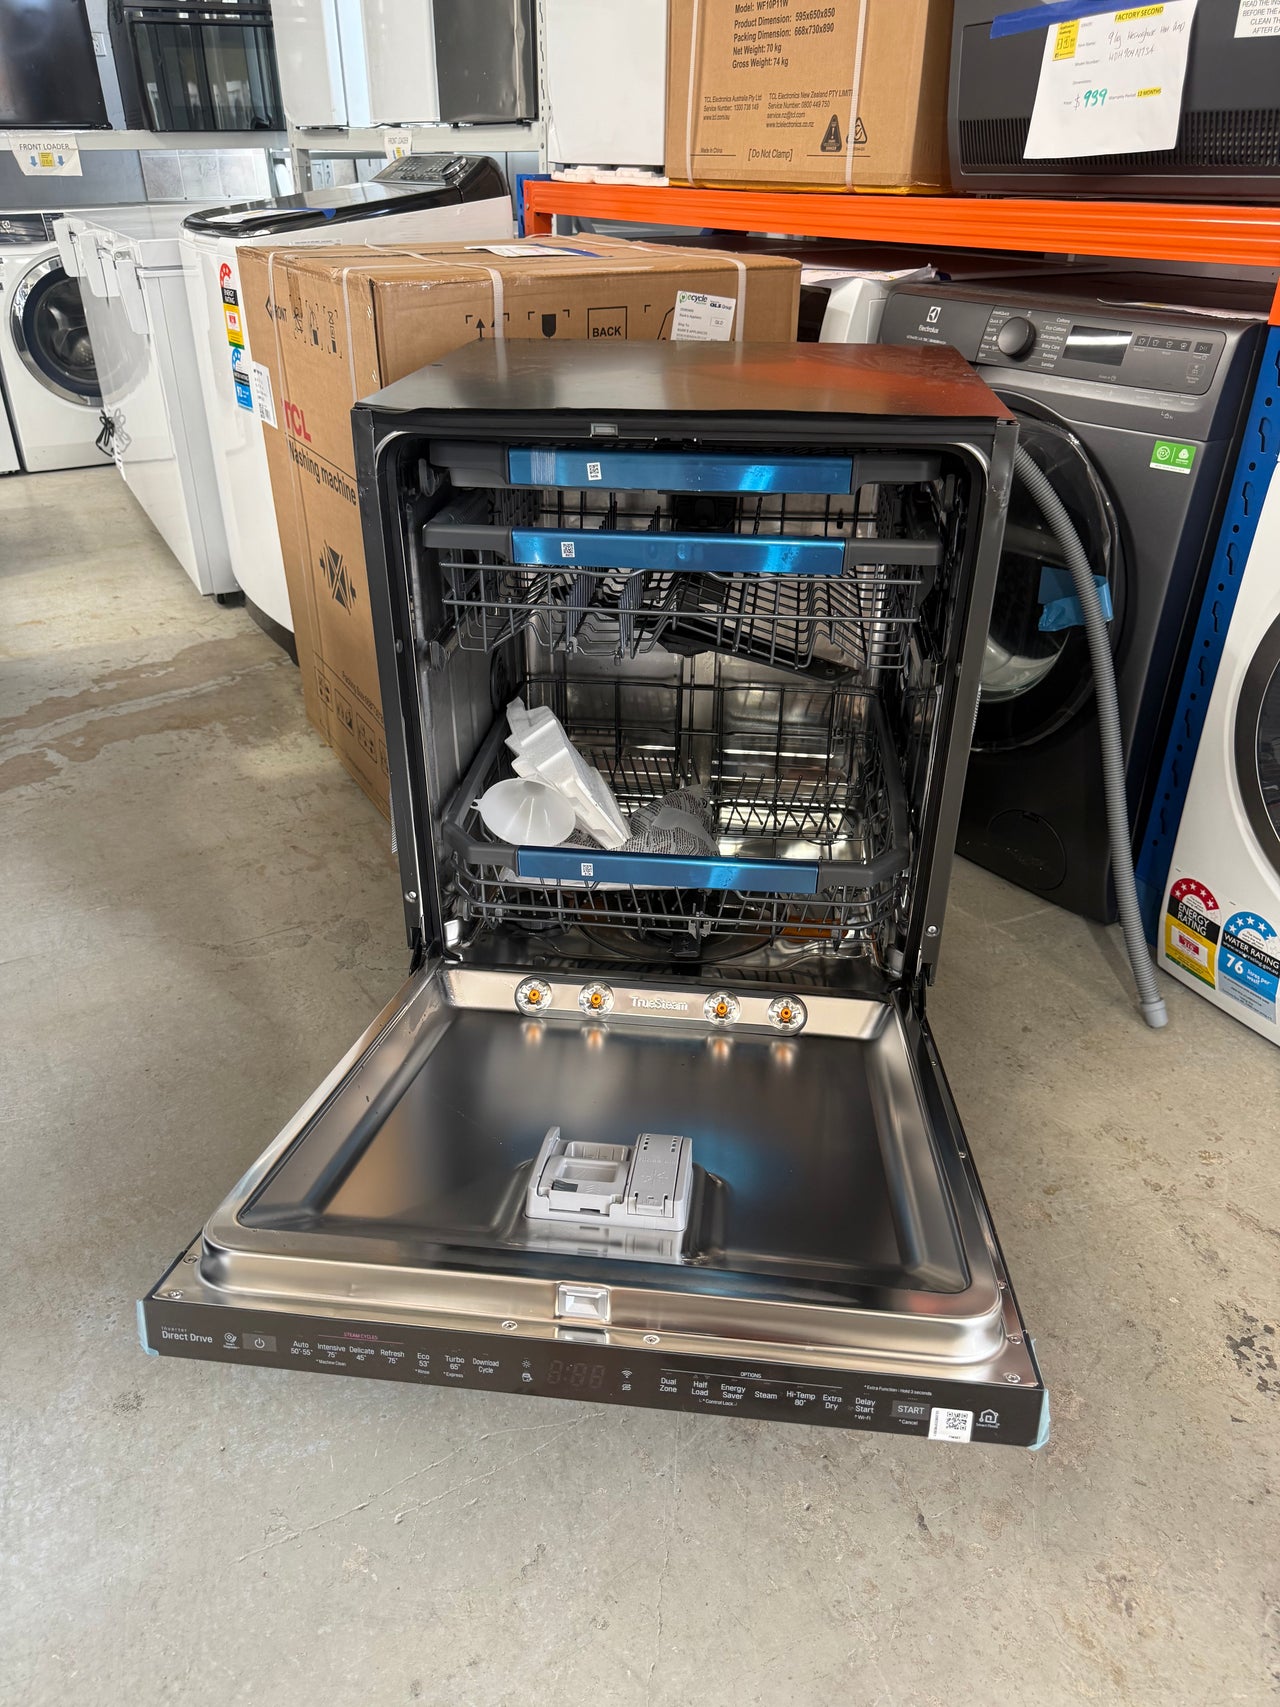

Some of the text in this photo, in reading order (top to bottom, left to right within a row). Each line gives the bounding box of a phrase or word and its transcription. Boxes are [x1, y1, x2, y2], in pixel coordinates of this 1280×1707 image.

[735, 4, 754, 14] Model:
[1114, 6, 1164, 21] FACTORY SECOND
[1242, 8, 1266, 16] BEFORE
[734, 7, 835, 29] Product Dimension: 595x650x850
[733, 22, 834, 43] Packing Dimension: 668x730x890
[1252, 26, 1272, 34] AFTER
[733, 43, 782, 56] Net Weight: 70 kg
[732, 57, 789, 69] Gross Weight: 74 kg
[769, 92, 777, 100] TCL
[778, 92, 799, 100] Electronics
[810, 90, 828, 98] Zealand
[768, 102, 783, 110] Service
[19, 143, 42, 151] FRONT
[761, 148, 771, 159] Not
[592, 326, 621, 338] BACK
[918, 324, 939, 334] Electrolux
[281, 398, 312, 443] TCL
[321, 463, 357, 506] machine
[1178, 902, 1209, 927] ENERGY
[1177, 912, 1207, 936] RATING
[1224, 932, 1249, 953] WATER
[1250, 948, 1279, 969] RATING
[1226, 953, 1244, 975] 76
[631, 995, 688, 1012] TrueSteam
[161, 1330, 213, 1343] Direct Drive
[292, 1340, 309, 1349] Auto
[317, 1343, 346, 1352] Intensive
[349, 1346, 375, 1355] Delicate
[380, 1349, 405, 1358] Refresh
[417, 1352, 430, 1360] Eco
[445, 1354, 464, 1363] Turbo
[472, 1358, 500, 1367] Download
[478, 1366, 494, 1374] Cycle
[660, 1377, 677, 1385] Dual
[659, 1385, 677, 1393] Zone
[691, 1388, 709, 1396] Load
[720, 1383, 746, 1393] Energy
[722, 1391, 743, 1399] Saver
[754, 1390, 778, 1399] Steam
[786, 1391, 816, 1401] Hi-Temp
[822, 1393, 842, 1403] Extra
[794, 1398, 806, 1407] 80°
[825, 1402, 839, 1411] Dry
[855, 1397, 876, 1407] Delay
[855, 1405, 874, 1413] Start
[897, 1405, 925, 1414] START
